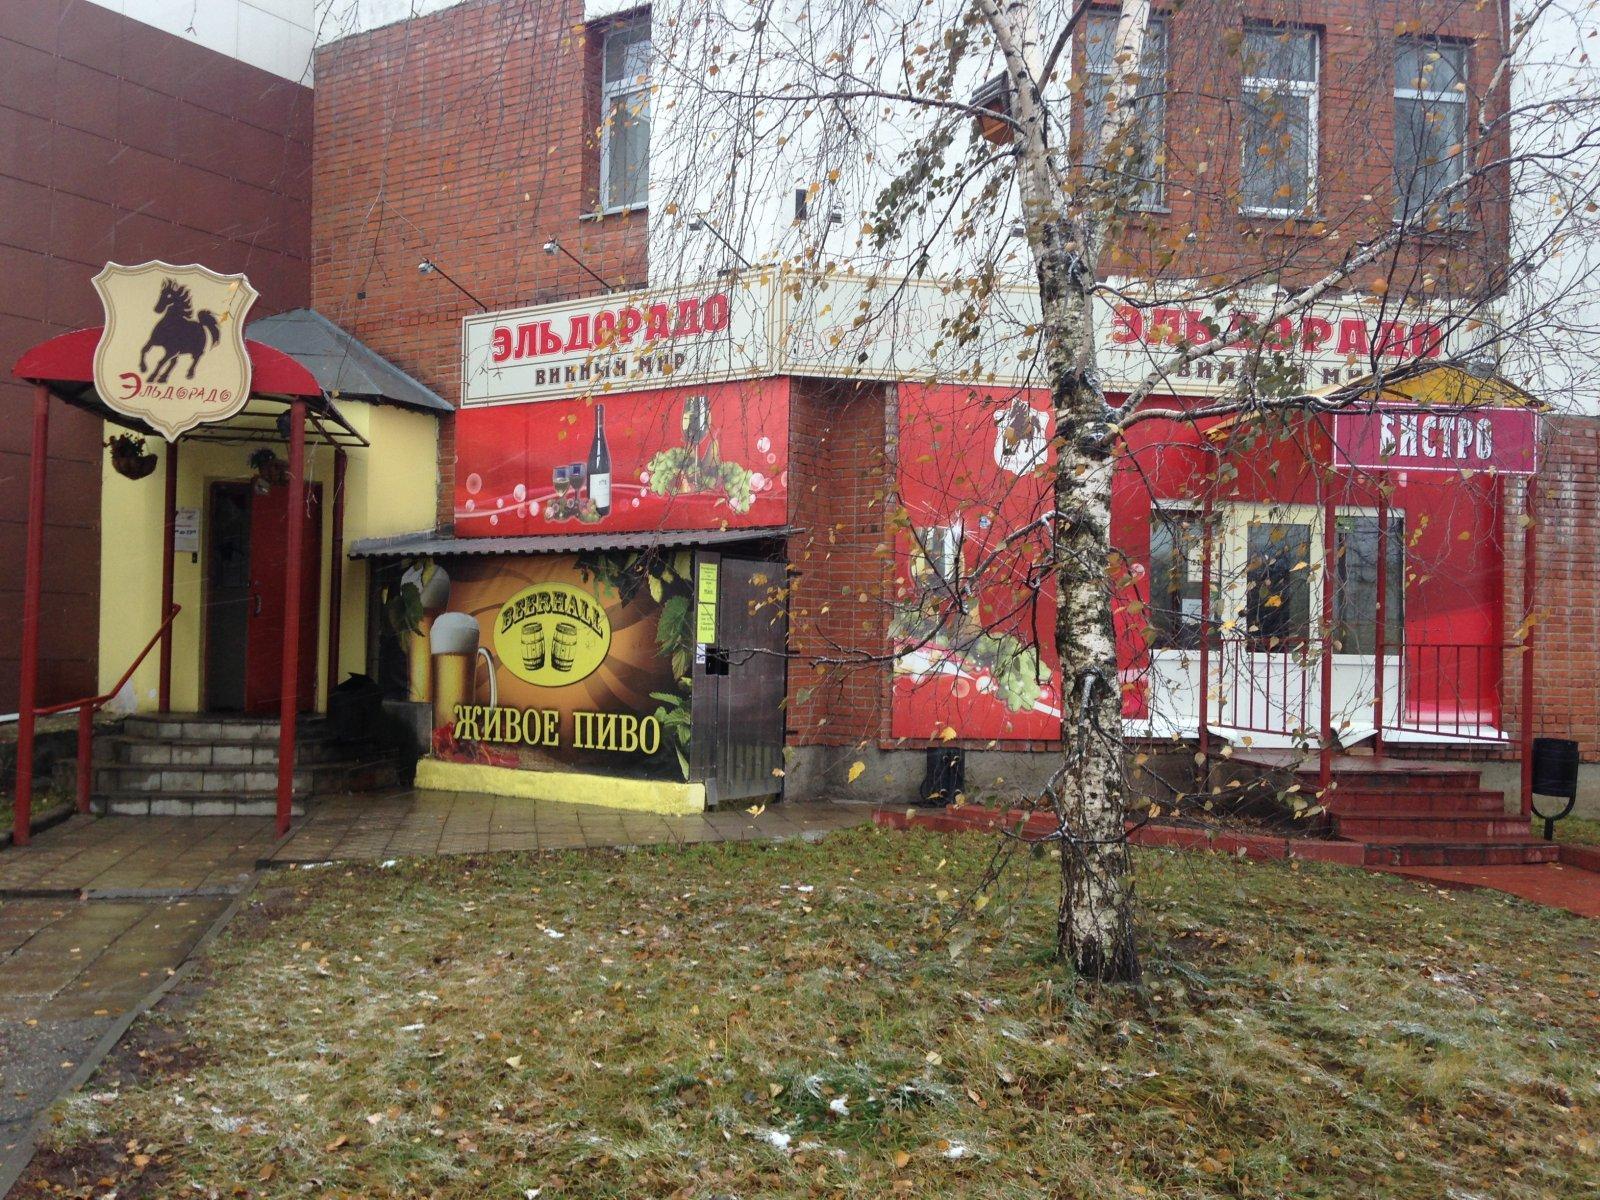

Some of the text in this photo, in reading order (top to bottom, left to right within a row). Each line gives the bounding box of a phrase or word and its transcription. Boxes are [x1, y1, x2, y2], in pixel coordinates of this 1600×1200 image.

[492, 293, 730, 363] ЭЛЬДОРАДО
[1379, 413, 1492, 460] БИСТРО
[501, 591, 604, 639] BEERHALL
[453, 705, 660, 754] ЖИВОЕ ПИВО
